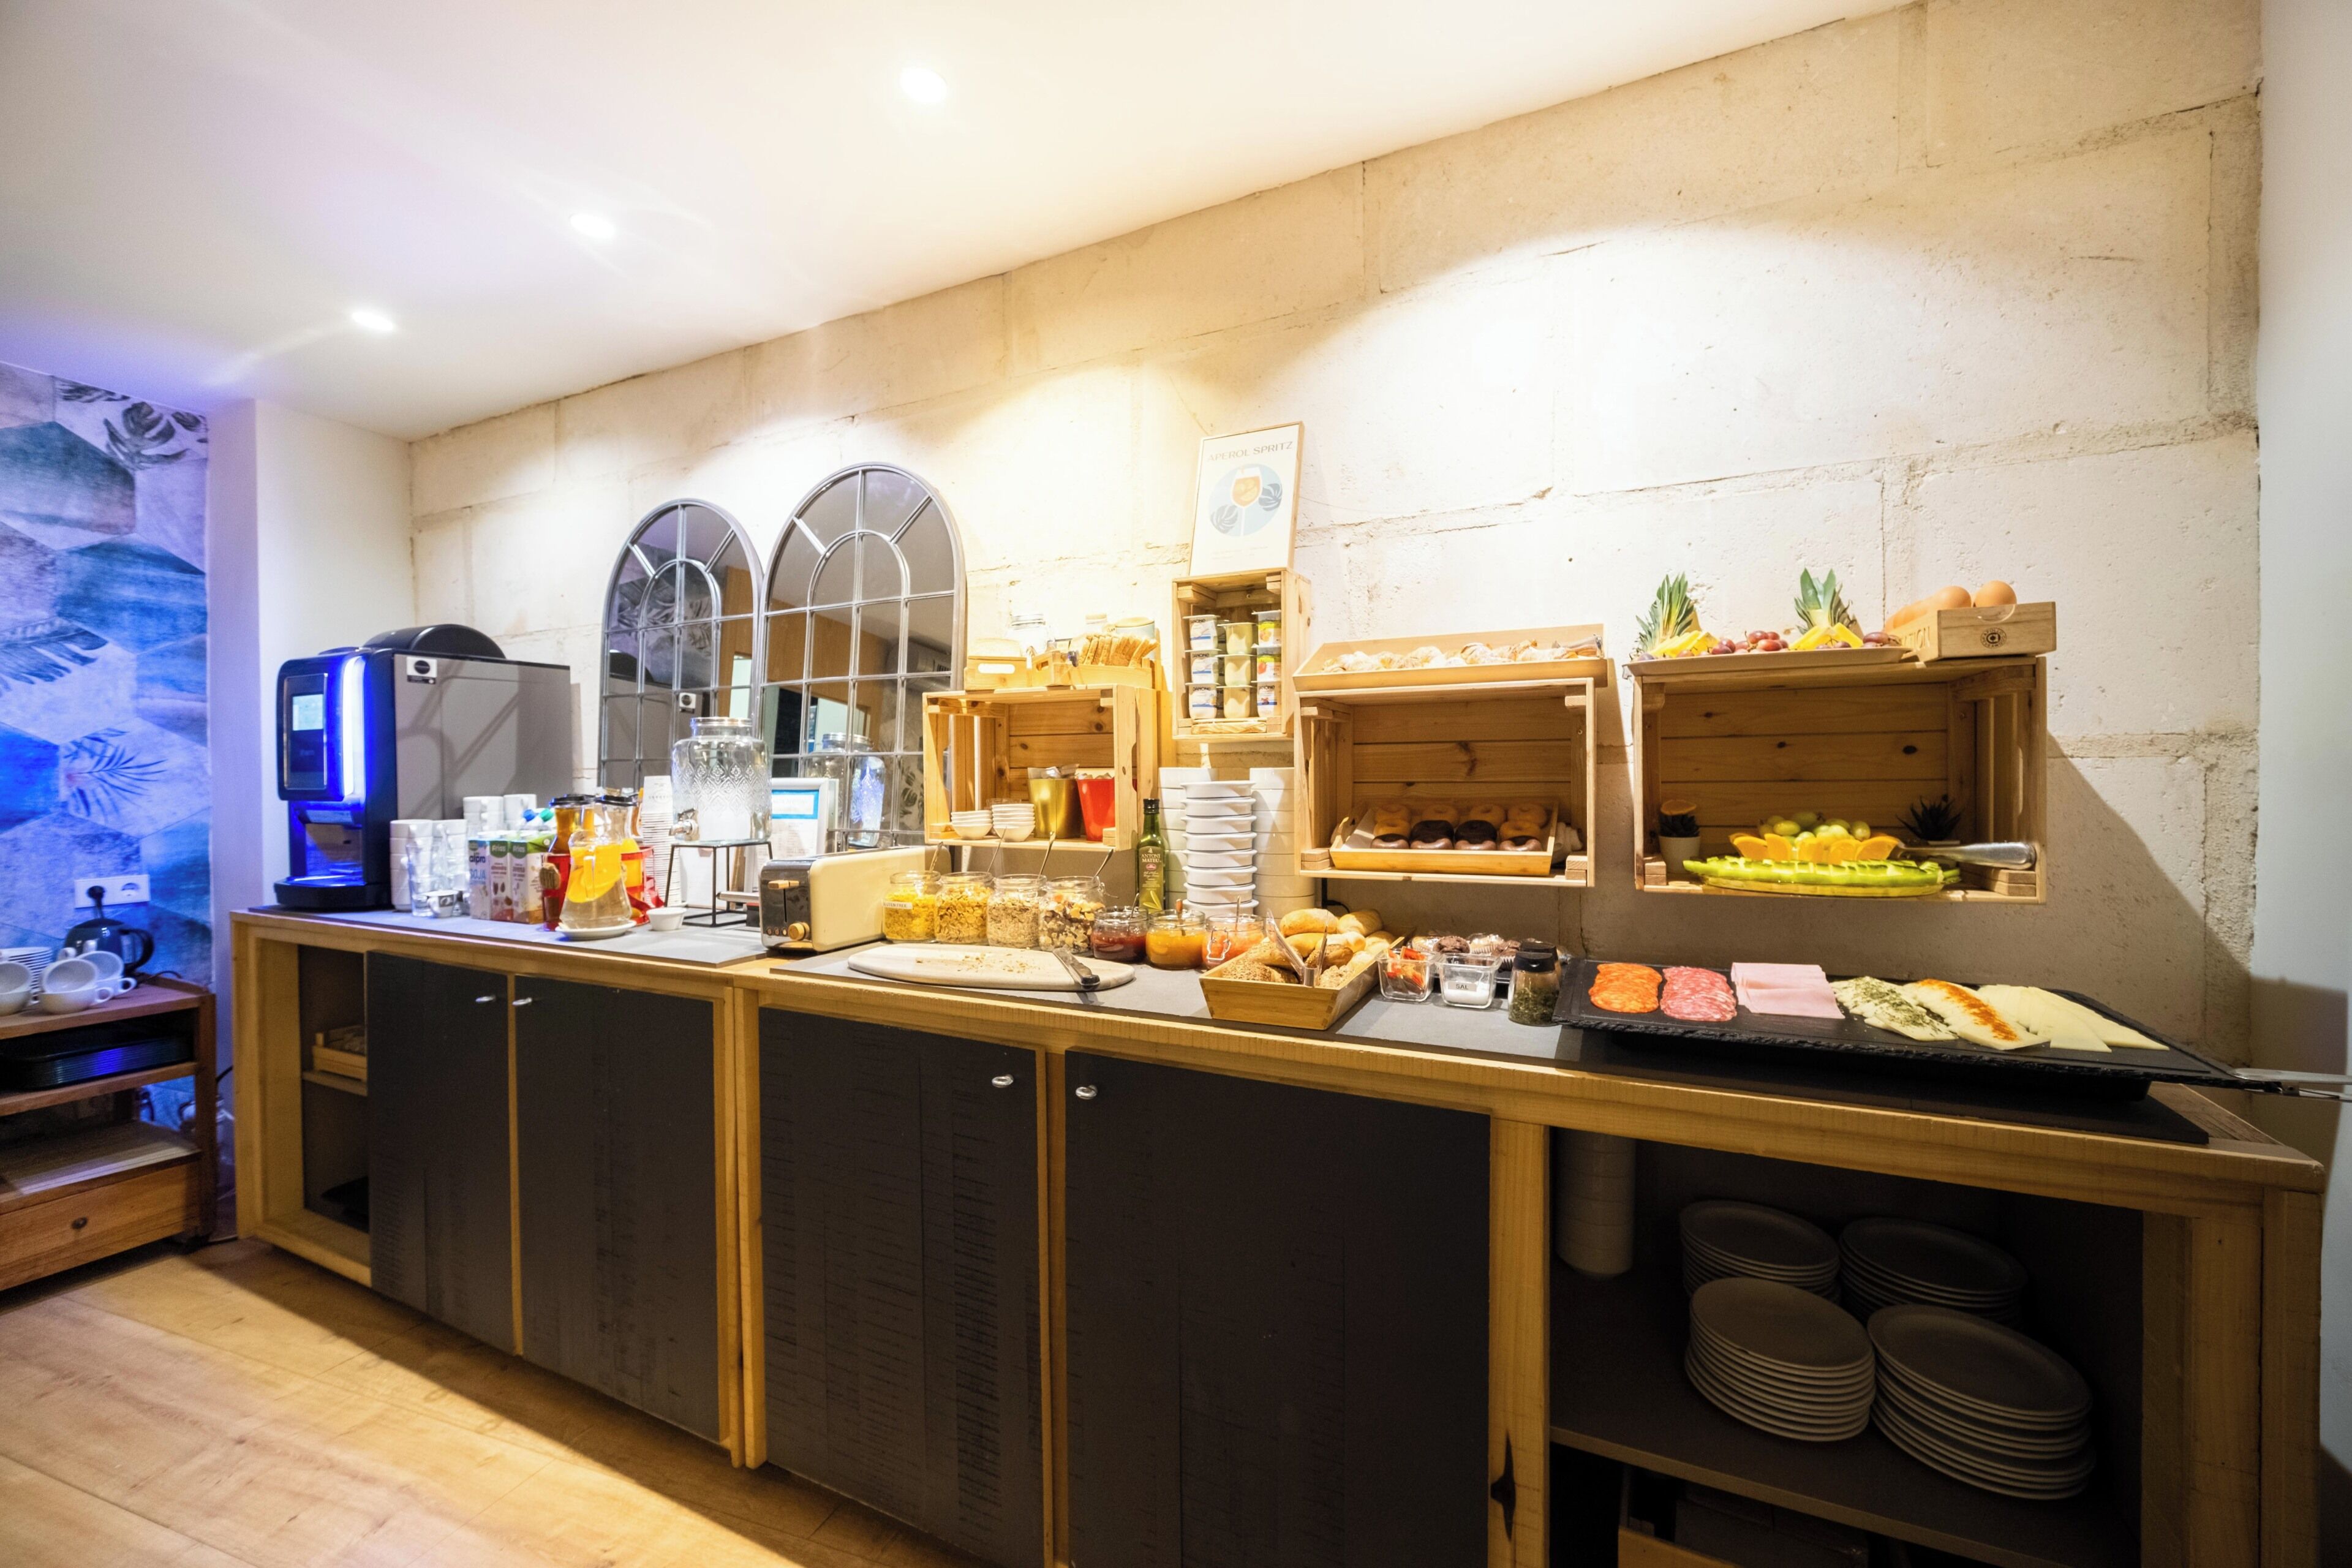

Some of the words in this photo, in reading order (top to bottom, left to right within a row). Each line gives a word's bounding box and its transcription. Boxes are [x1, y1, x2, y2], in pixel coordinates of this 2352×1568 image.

[1208, 449, 1250, 461] APEROL
[1253, 441, 1293, 455] SPRITZ
[469, 853, 486, 864] alpro
